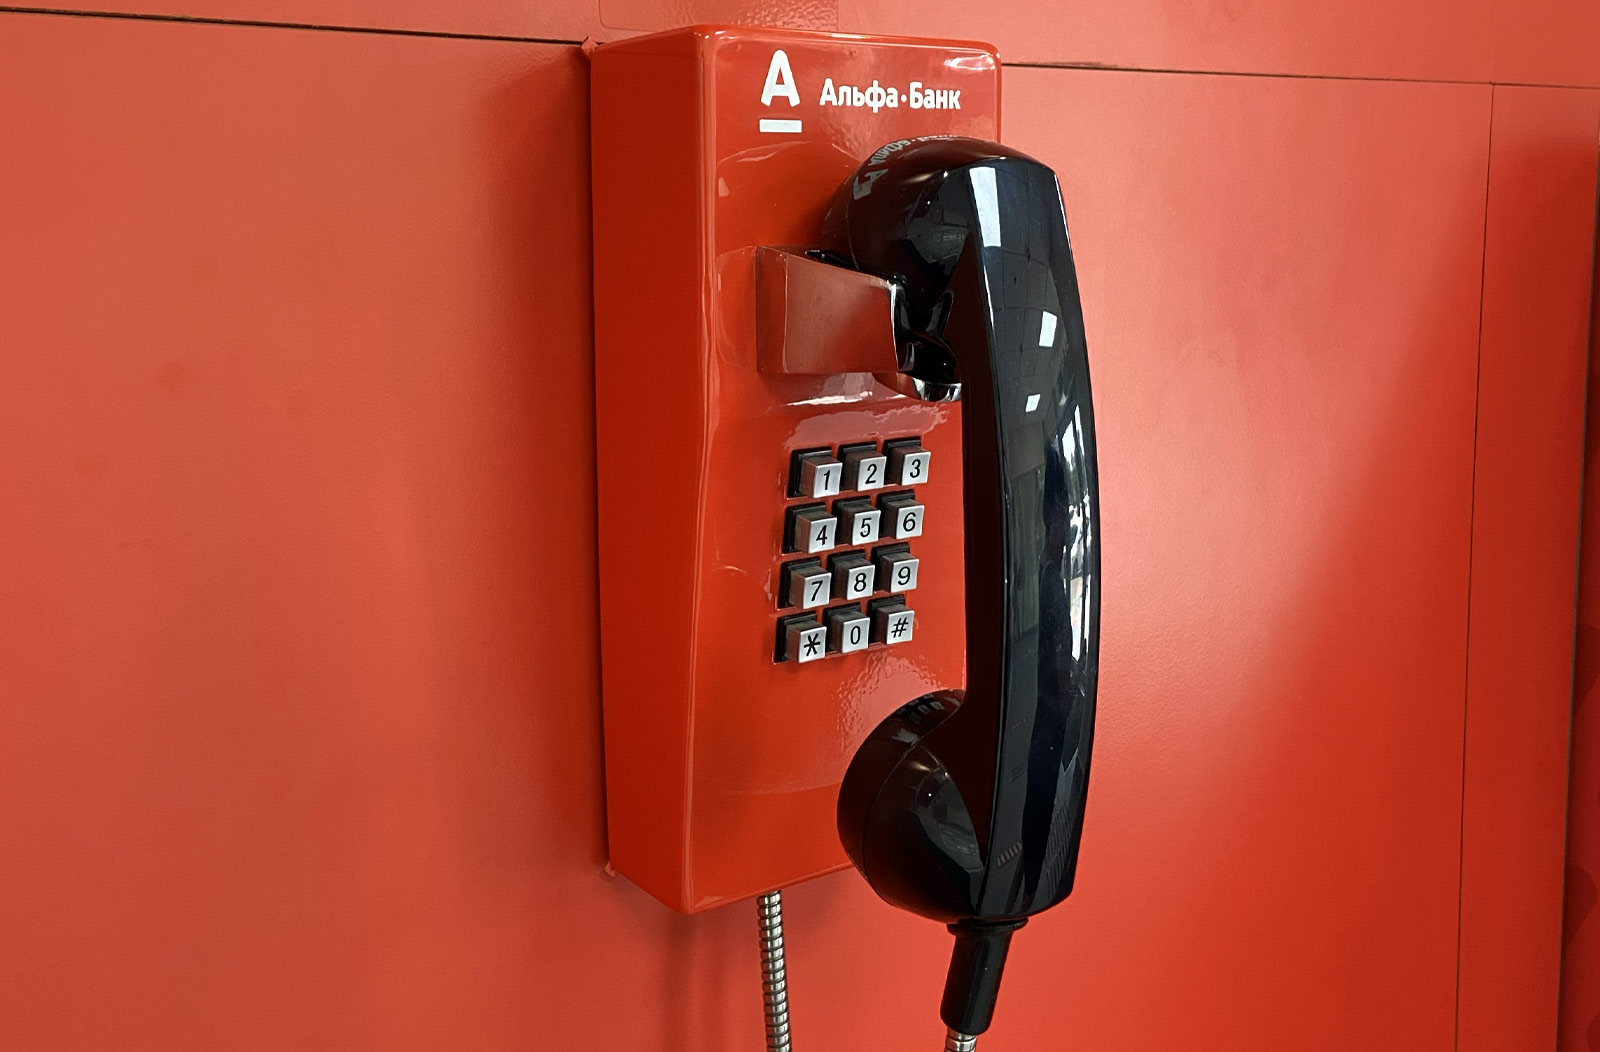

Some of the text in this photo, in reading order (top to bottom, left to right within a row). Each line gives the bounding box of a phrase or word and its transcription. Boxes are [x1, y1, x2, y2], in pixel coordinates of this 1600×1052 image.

[865, 463, 878, 485] 2
[909, 458, 922, 479] 3
[815, 511, 917, 546] 4 5 6
[810, 565, 911, 602] 7 8 9
[850, 625, 861, 645] 0
[890, 616, 909, 639] #
